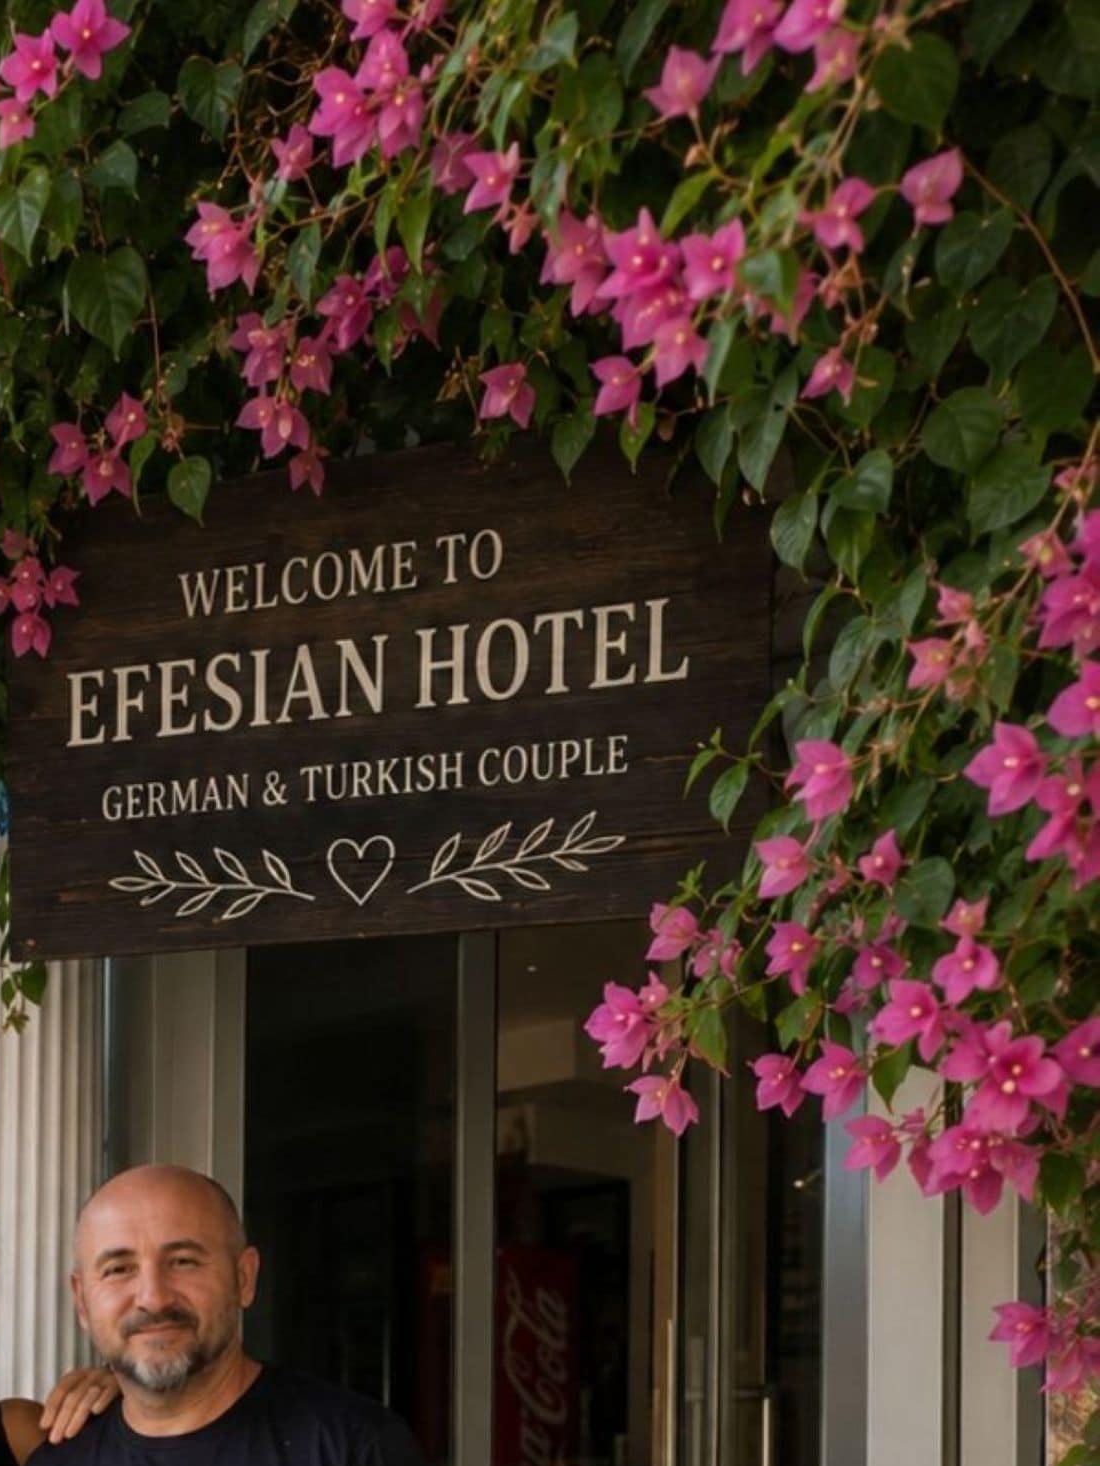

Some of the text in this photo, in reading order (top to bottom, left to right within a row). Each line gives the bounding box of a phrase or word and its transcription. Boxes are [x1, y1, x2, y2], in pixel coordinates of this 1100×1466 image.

[179, 528, 503, 618] WELCOME TO
[66, 598, 689, 748] EFESIAN HOTEL
[102, 735, 629, 822] GERMAN & TURKISH COUPLE
